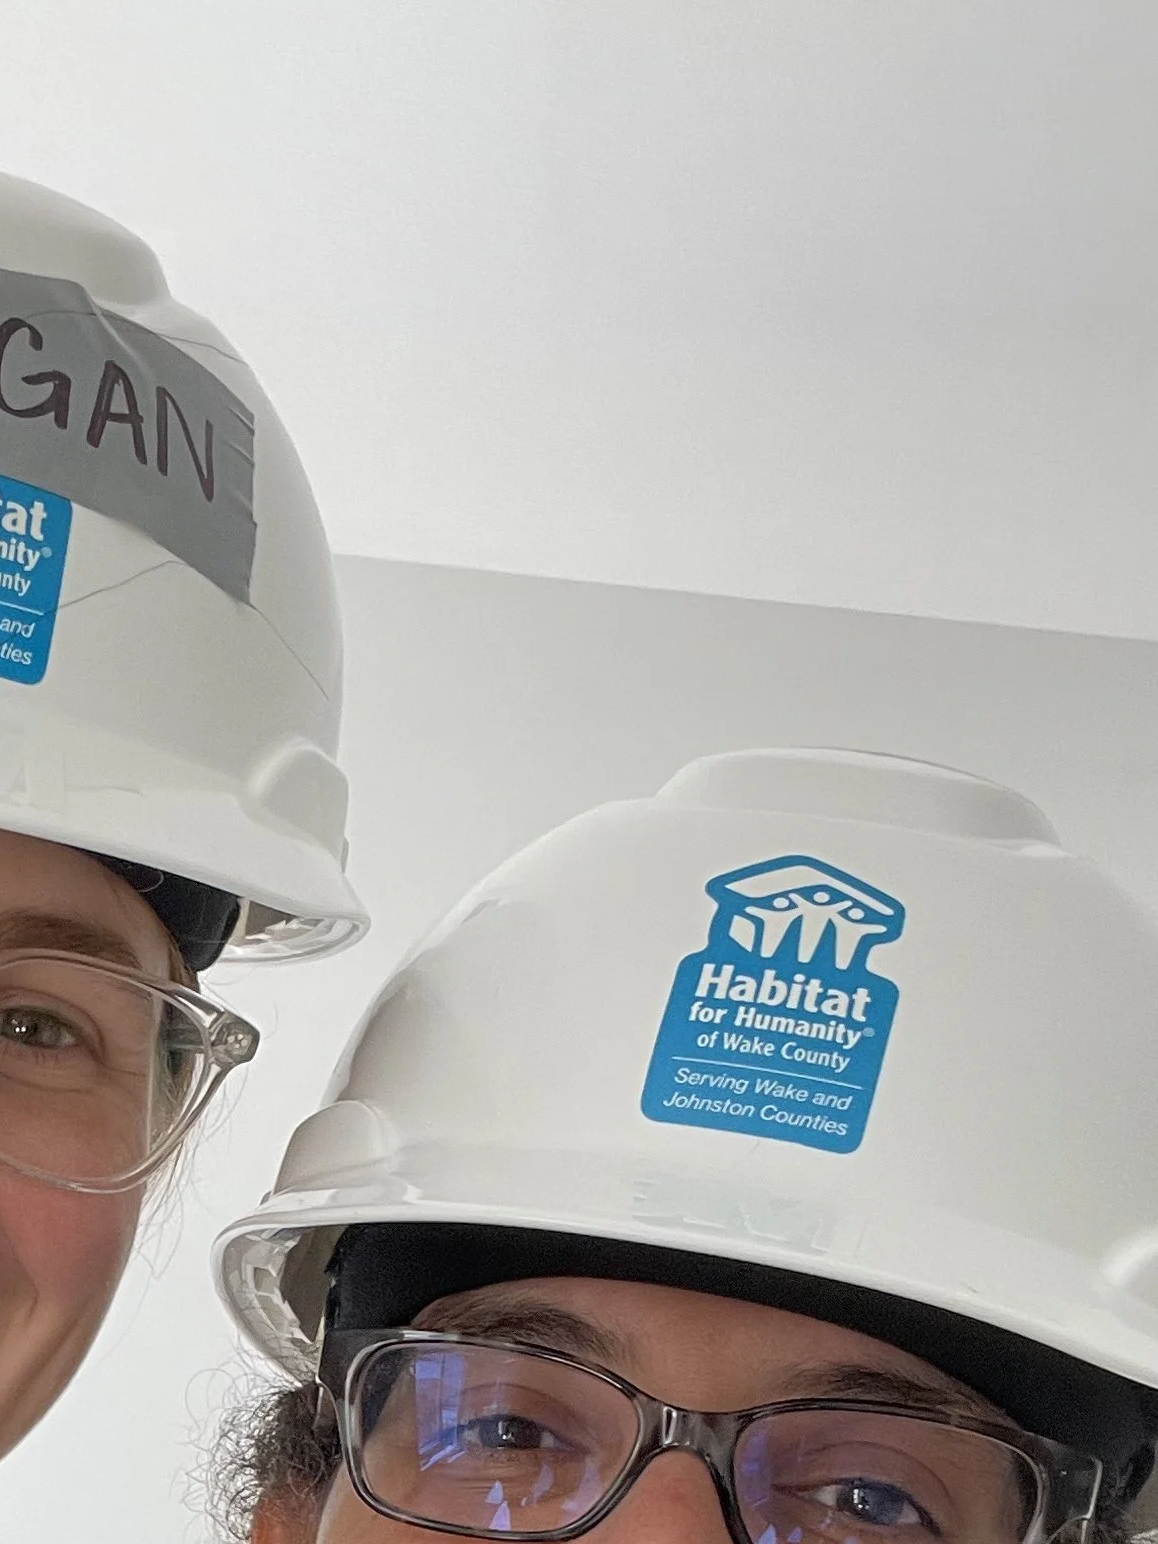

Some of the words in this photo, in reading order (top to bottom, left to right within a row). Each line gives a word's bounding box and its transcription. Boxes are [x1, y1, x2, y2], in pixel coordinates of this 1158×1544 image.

[0, 615, 36, 638] and
[688, 1001, 728, 1024] for
[694, 963, 872, 1022] Habitat
[697, 1031, 721, 1048] of
[723, 1032, 775, 1057] Wake
[781, 1041, 851, 1074] County
[674, 1067, 749, 1095] Serving
[754, 1078, 809, 1103] Wake
[812, 1090, 853, 1111] and
[663, 1091, 756, 1118] Johnston
[760, 1103, 850, 1136] Counties
